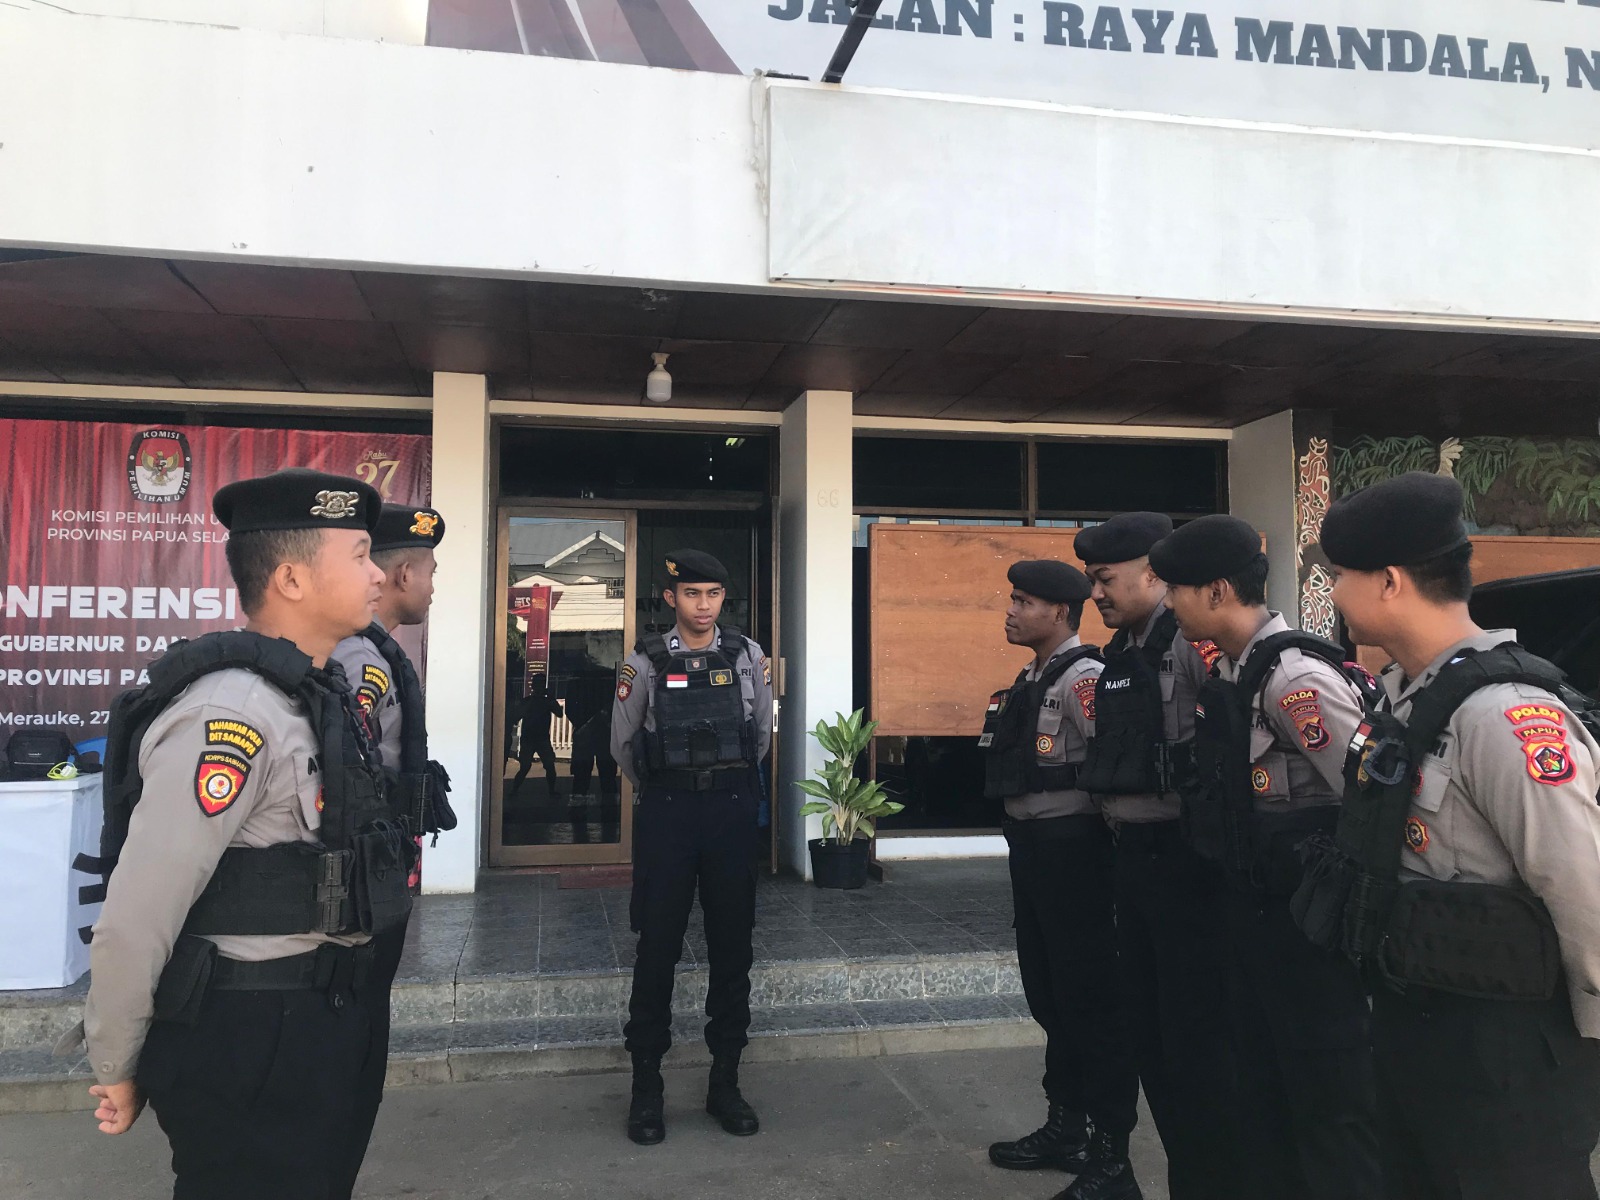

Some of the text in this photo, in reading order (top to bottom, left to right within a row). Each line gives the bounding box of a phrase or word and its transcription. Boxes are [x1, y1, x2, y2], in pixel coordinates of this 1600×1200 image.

[768, 0, 992, 38] JAAN
[1043, 1, 1218, 58] RAYA
[1235, 17, 1550, 93] MANDALA,
[143, 430, 180, 440] KOMISI
[355, 460, 400, 498] 27
[51, 510, 110, 523] KOMISI
[115, 511, 204, 525] PEMILIHAN
[47, 528, 126, 541] PROVINSI
[132, 530, 188, 543] PAPUA
[0, 585, 236, 620] NFERENSI
[0, 635, 125, 652] GUBERNUR
[0, 668, 110, 686] PROVINSI
[1282, 690, 1314, 706] POLDA
[0, 710, 110, 727] Merauke, 27
[1291, 705, 1316, 717] PAPUA
[1512, 706, 1560, 721] POLDA
[1523, 727, 1560, 737] PAPUA
